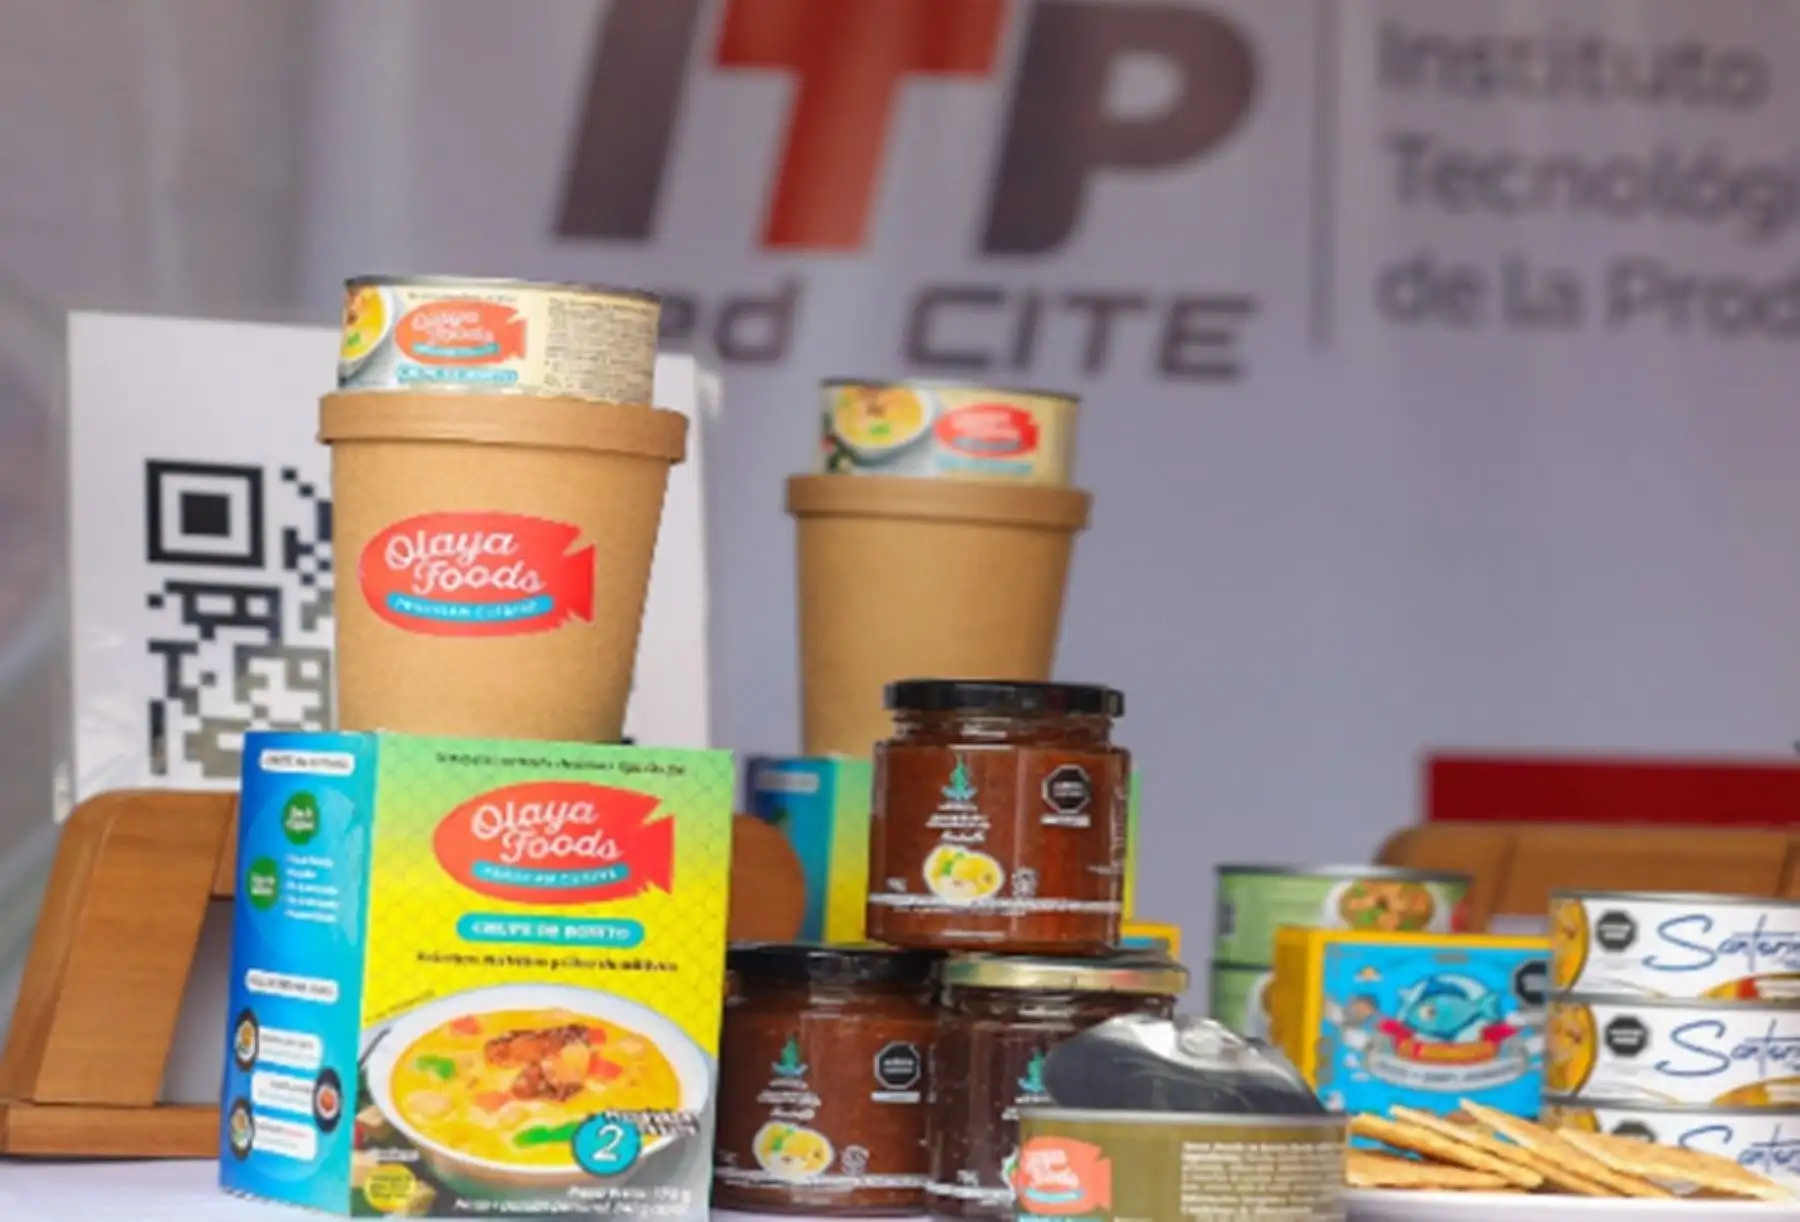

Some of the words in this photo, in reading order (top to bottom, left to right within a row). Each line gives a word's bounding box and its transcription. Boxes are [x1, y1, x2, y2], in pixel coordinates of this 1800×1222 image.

[1376, 20, 1772, 112] Instituto
[552, 0, 1262, 260] ITP
[1380, 130, 1800, 246] Tecnológ
[1373, 246, 1487, 331] de
[1500, 247, 1584, 333] la
[1604, 252, 1800, 344] Prod
[905, 283, 1258, 381] CITE
[385, 529, 519, 570] Olaya
[411, 560, 546, 596] Foods
[470, 800, 600, 841] Olaya
[500, 828, 624, 864] Foods
[590, 1123, 624, 1163] 2
